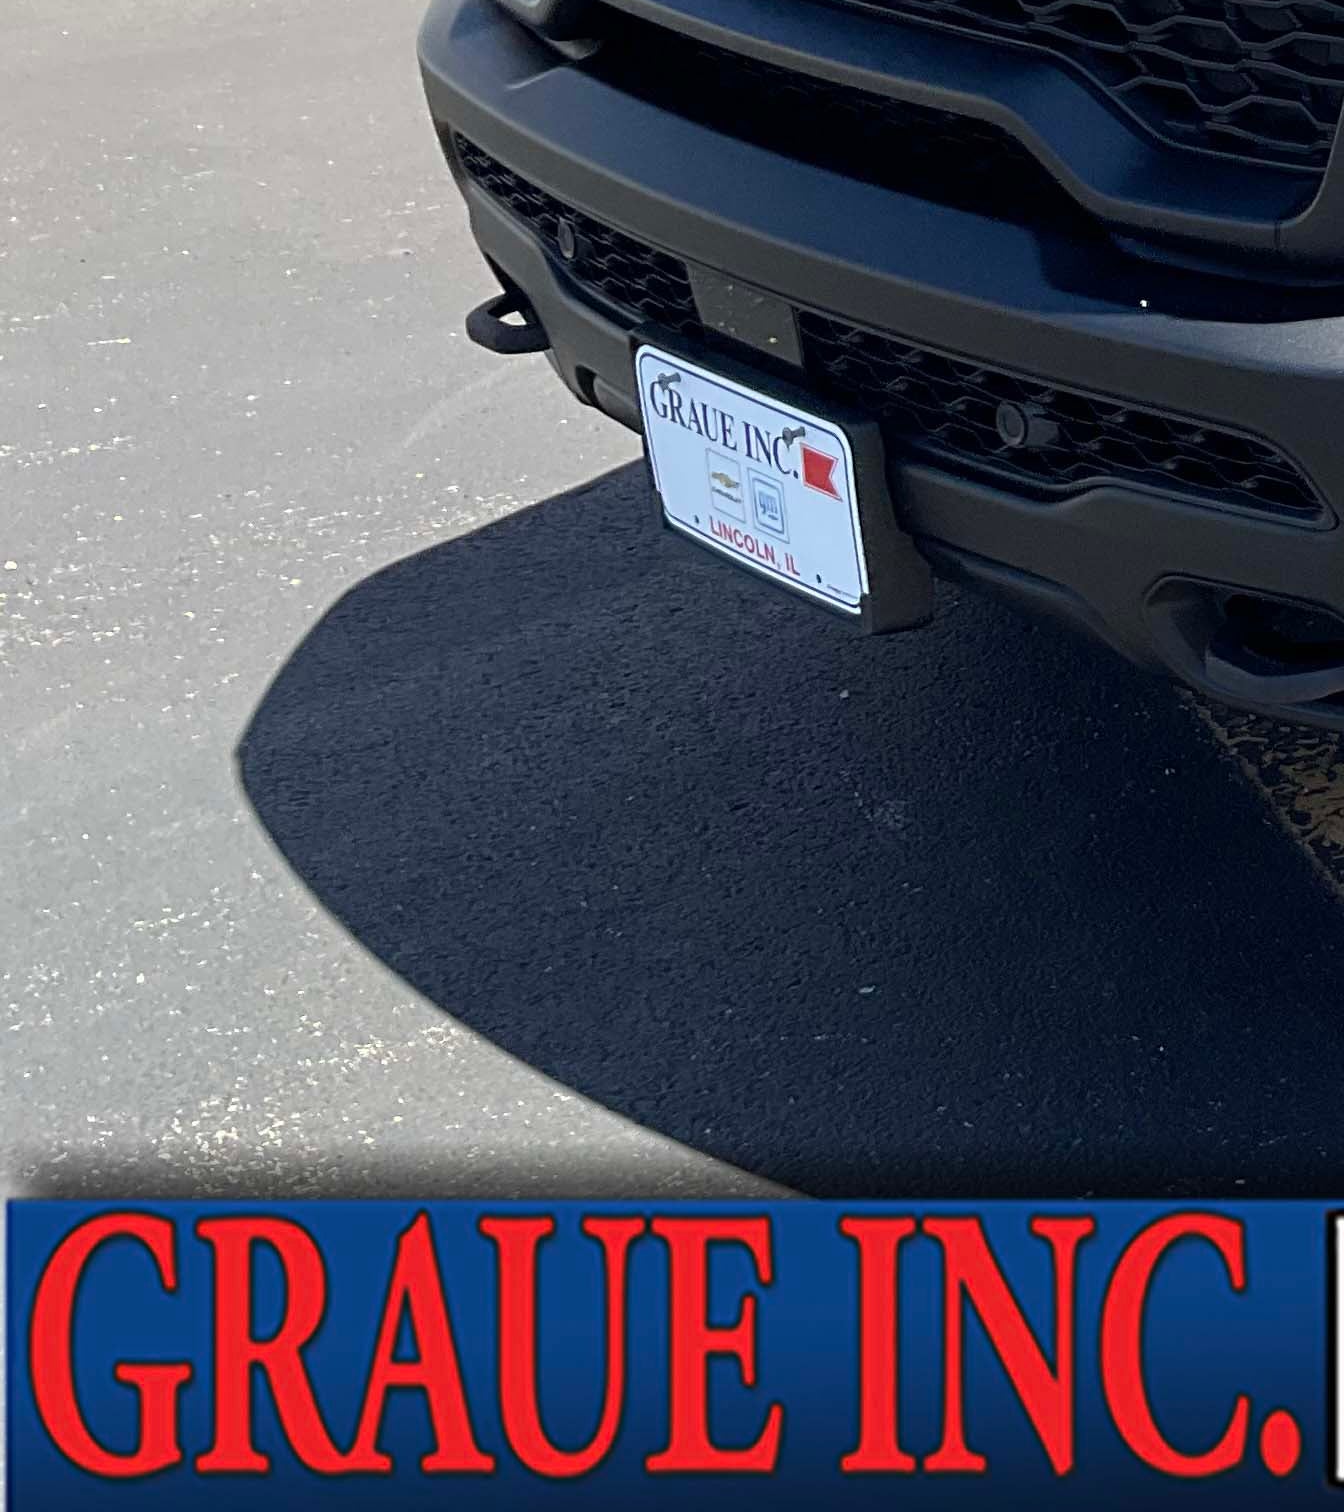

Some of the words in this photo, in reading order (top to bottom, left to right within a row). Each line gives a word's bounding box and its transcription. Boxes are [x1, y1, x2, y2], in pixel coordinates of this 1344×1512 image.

[651, 380, 737, 452] GRAUE
[742, 420, 798, 479] INC.
[784, 552, 801, 576] IL
